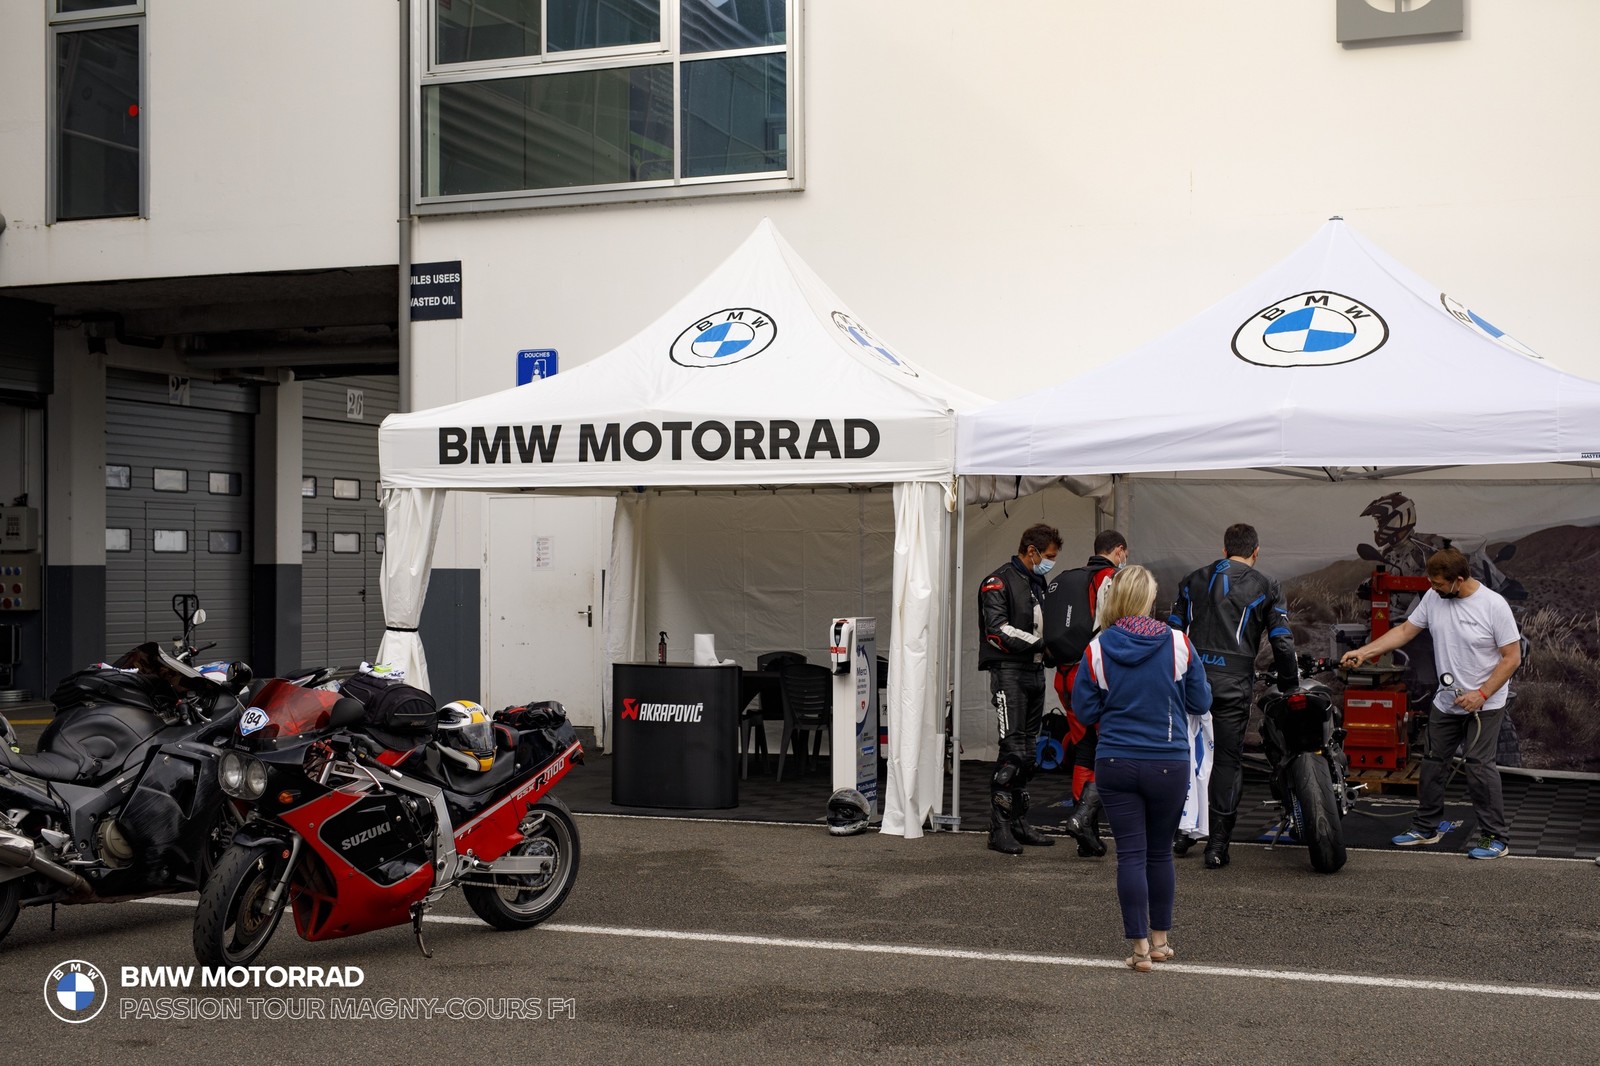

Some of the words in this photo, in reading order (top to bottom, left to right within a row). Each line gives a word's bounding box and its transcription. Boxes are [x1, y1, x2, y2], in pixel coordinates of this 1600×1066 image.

[433, 273, 461, 284] USEES
[442, 295, 456, 306] OIL
[1261, 295, 1371, 321] BMW
[696, 312, 769, 332] BMW
[348, 392, 363, 416] 26
[438, 425, 562, 465] BMW
[579, 418, 881, 462] MOTORRAD
[243, 710, 262, 727] 184
[639, 703, 704, 723] AKRAPOVIČ
[341, 821, 391, 851] SUZUKI
